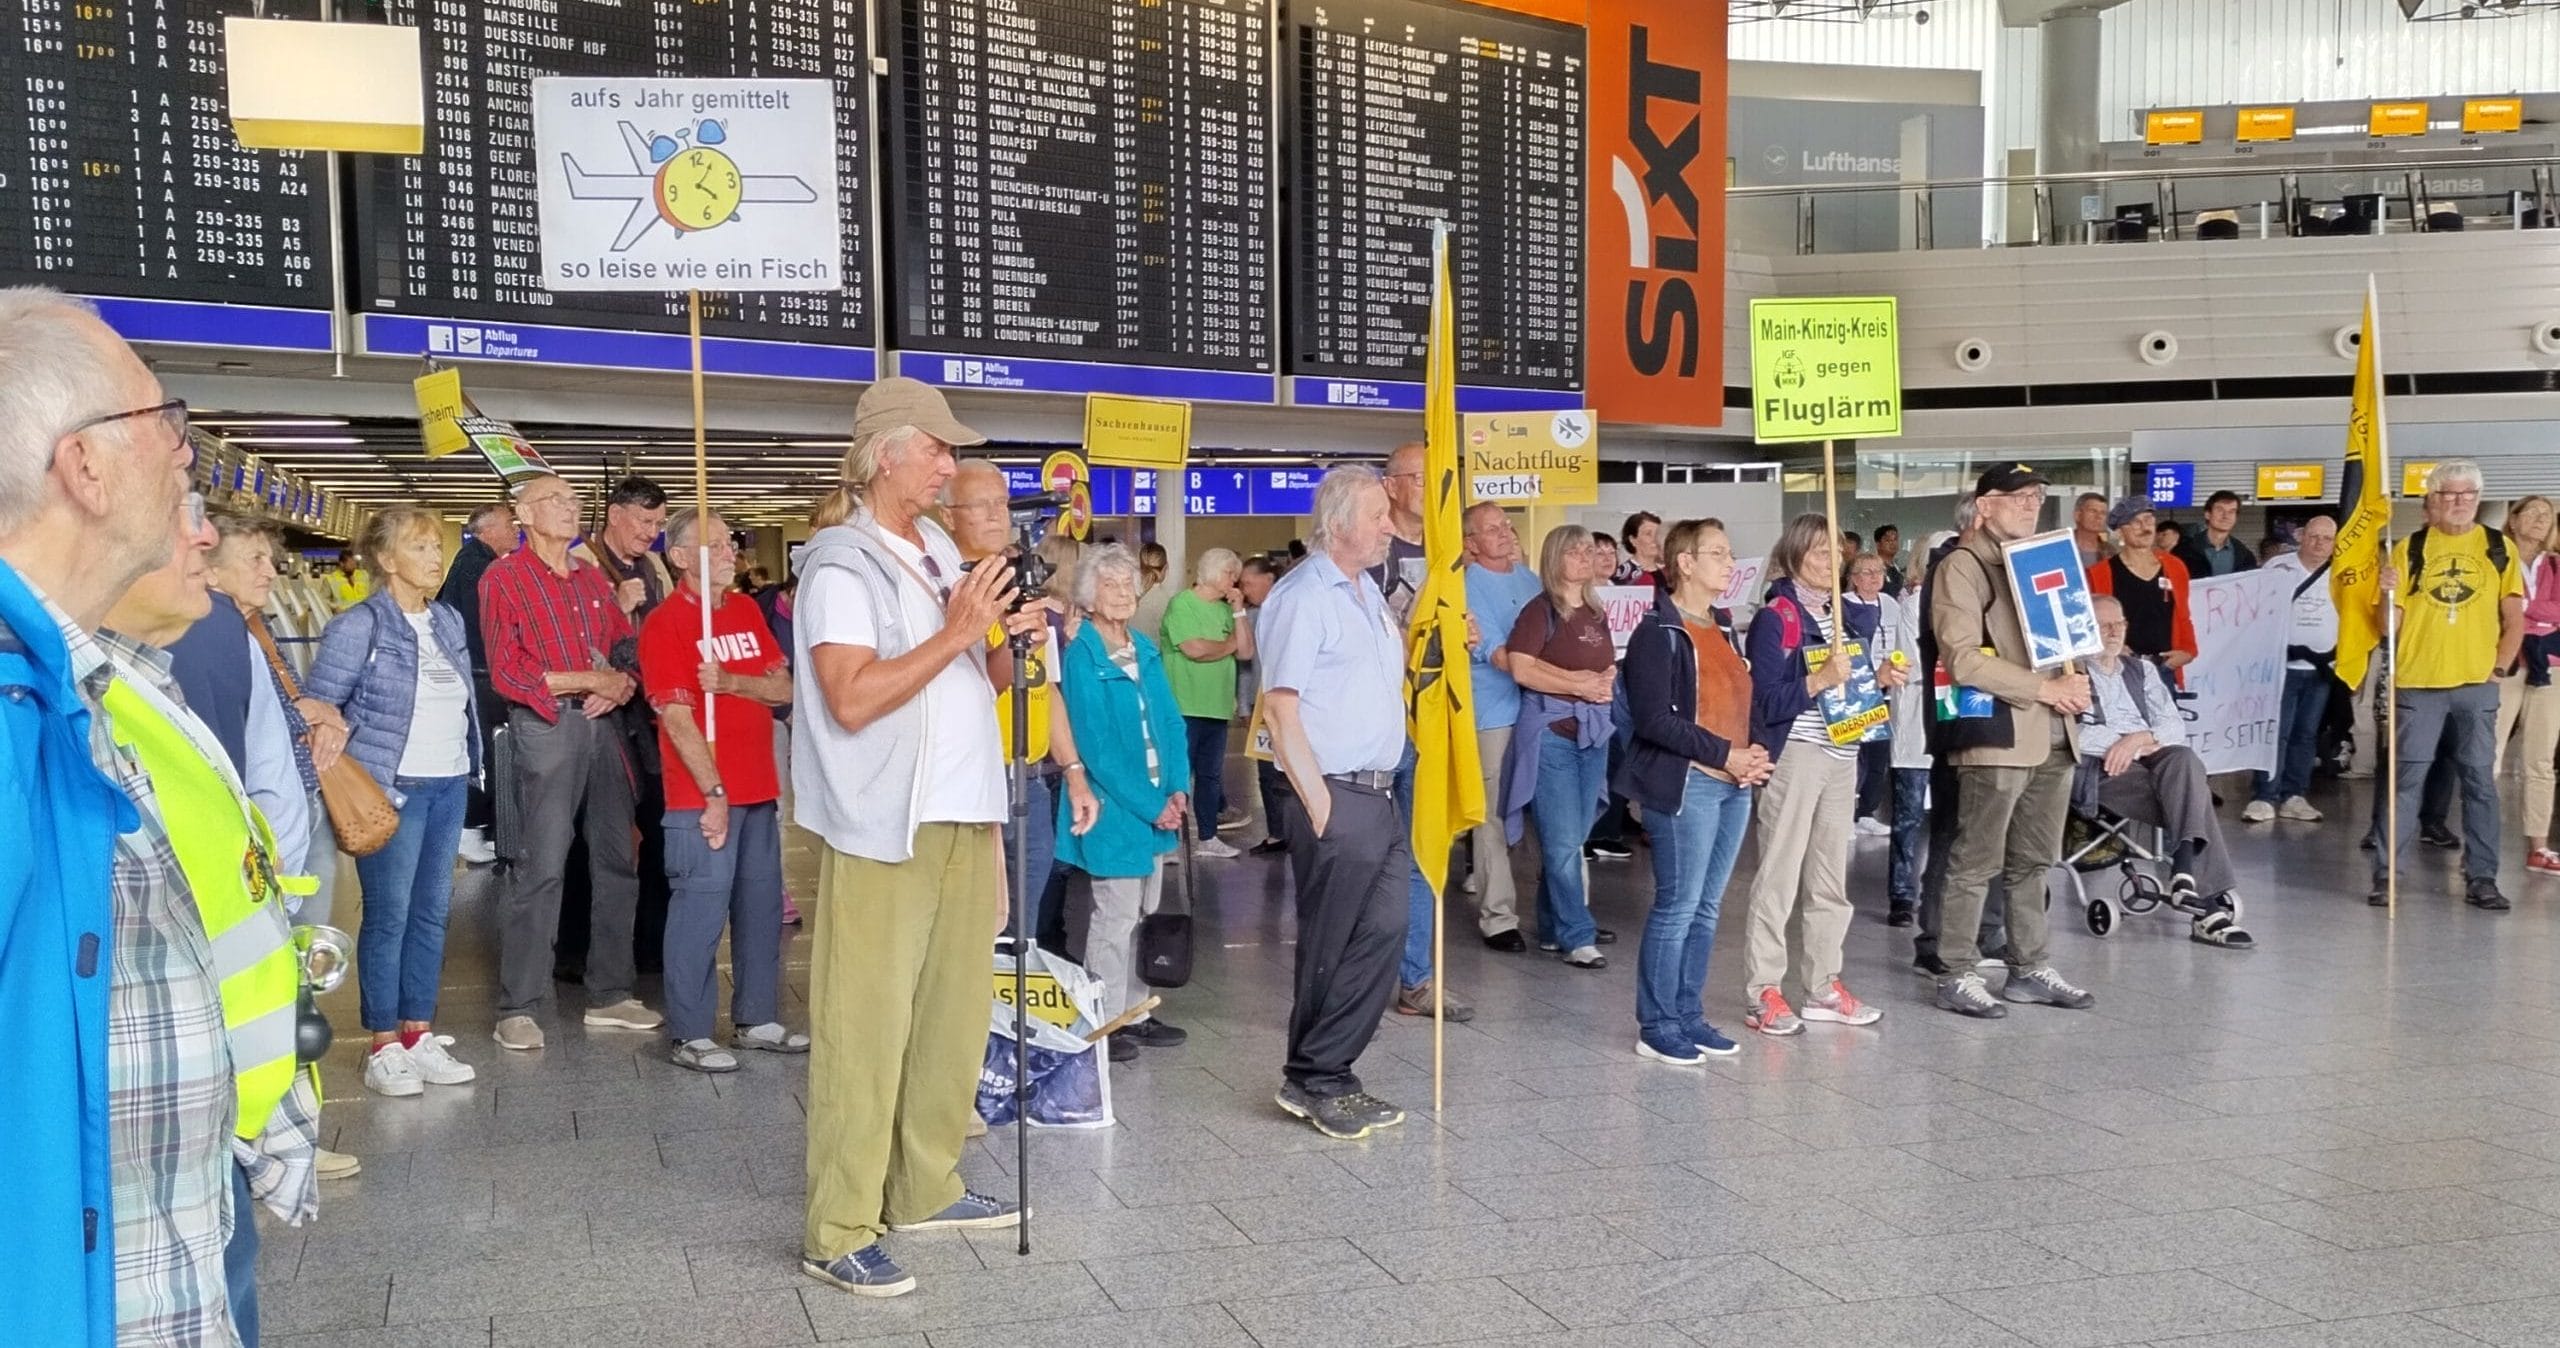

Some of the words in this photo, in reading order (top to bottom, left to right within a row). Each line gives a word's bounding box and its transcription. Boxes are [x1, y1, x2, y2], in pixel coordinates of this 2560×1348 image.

[434, 0, 466, 17] 1088
[433, 18, 467, 35] 3518
[443, 37, 467, 53] 912
[485, 26, 574, 50] DUESSELDORF
[583, 41, 606, 56] HBF
[444, 55, 468, 71] 996
[436, 72, 469, 88] 2614
[437, 90, 470, 106] 2050
[570, 87, 620, 109] aufs
[634, 88, 683, 109] Jahr
[692, 89, 790, 113] gemittelt
[437, 108, 470, 124] 8906
[440, 144, 472, 159] 1095
[490, 149, 521, 165] GENF
[689, 151, 704, 168] 12
[404, 157, 421, 171] EN
[439, 161, 472, 177] 8858
[1802, 150, 1901, 174] Lufthansa
[448, 180, 473, 195] 946
[726, 171, 736, 189] 3
[2373, 177, 2484, 195] Lufhansa
[669, 185, 678, 202] 9
[1626, 24, 1701, 378] SIXT
[442, 197, 474, 212] 1040
[492, 202, 533, 218] PARIS
[703, 205, 712, 220] 6
[442, 214, 474, 230] 3466
[451, 233, 475, 247] 328
[493, 237, 541, 254] VENEDI
[494, 254, 527, 269] BAKU
[560, 262, 590, 279] so
[600, 257, 656, 279] leise
[666, 258, 706, 279] wie
[716, 258, 751, 279] ein
[761, 257, 828, 279] Fisch
[452, 268, 477, 282] 818
[410, 282, 426, 296] LH
[453, 286, 477, 300] 840
[495, 289, 553, 306] BILLUND
[485, 329, 517, 344] Abflug
[1761, 316, 1888, 345] Main-Kinzig-Kreis
[486, 343, 538, 358] Departures
[1815, 360, 1871, 378] gegen
[1765, 395, 1892, 426] Fluglärm
[1095, 417, 1178, 433] Sachsenhausen
[1472, 449, 1590, 473] Nachtflug-
[1191, 472, 1201, 489] B
[1473, 475, 1544, 495] verbot
[2153, 476, 2182, 489] 313-
[1829, 706, 1887, 739] WIDERSTAND
[2223, 719, 2278, 749] SEITE
[993, 984, 1070, 1009] sadt
